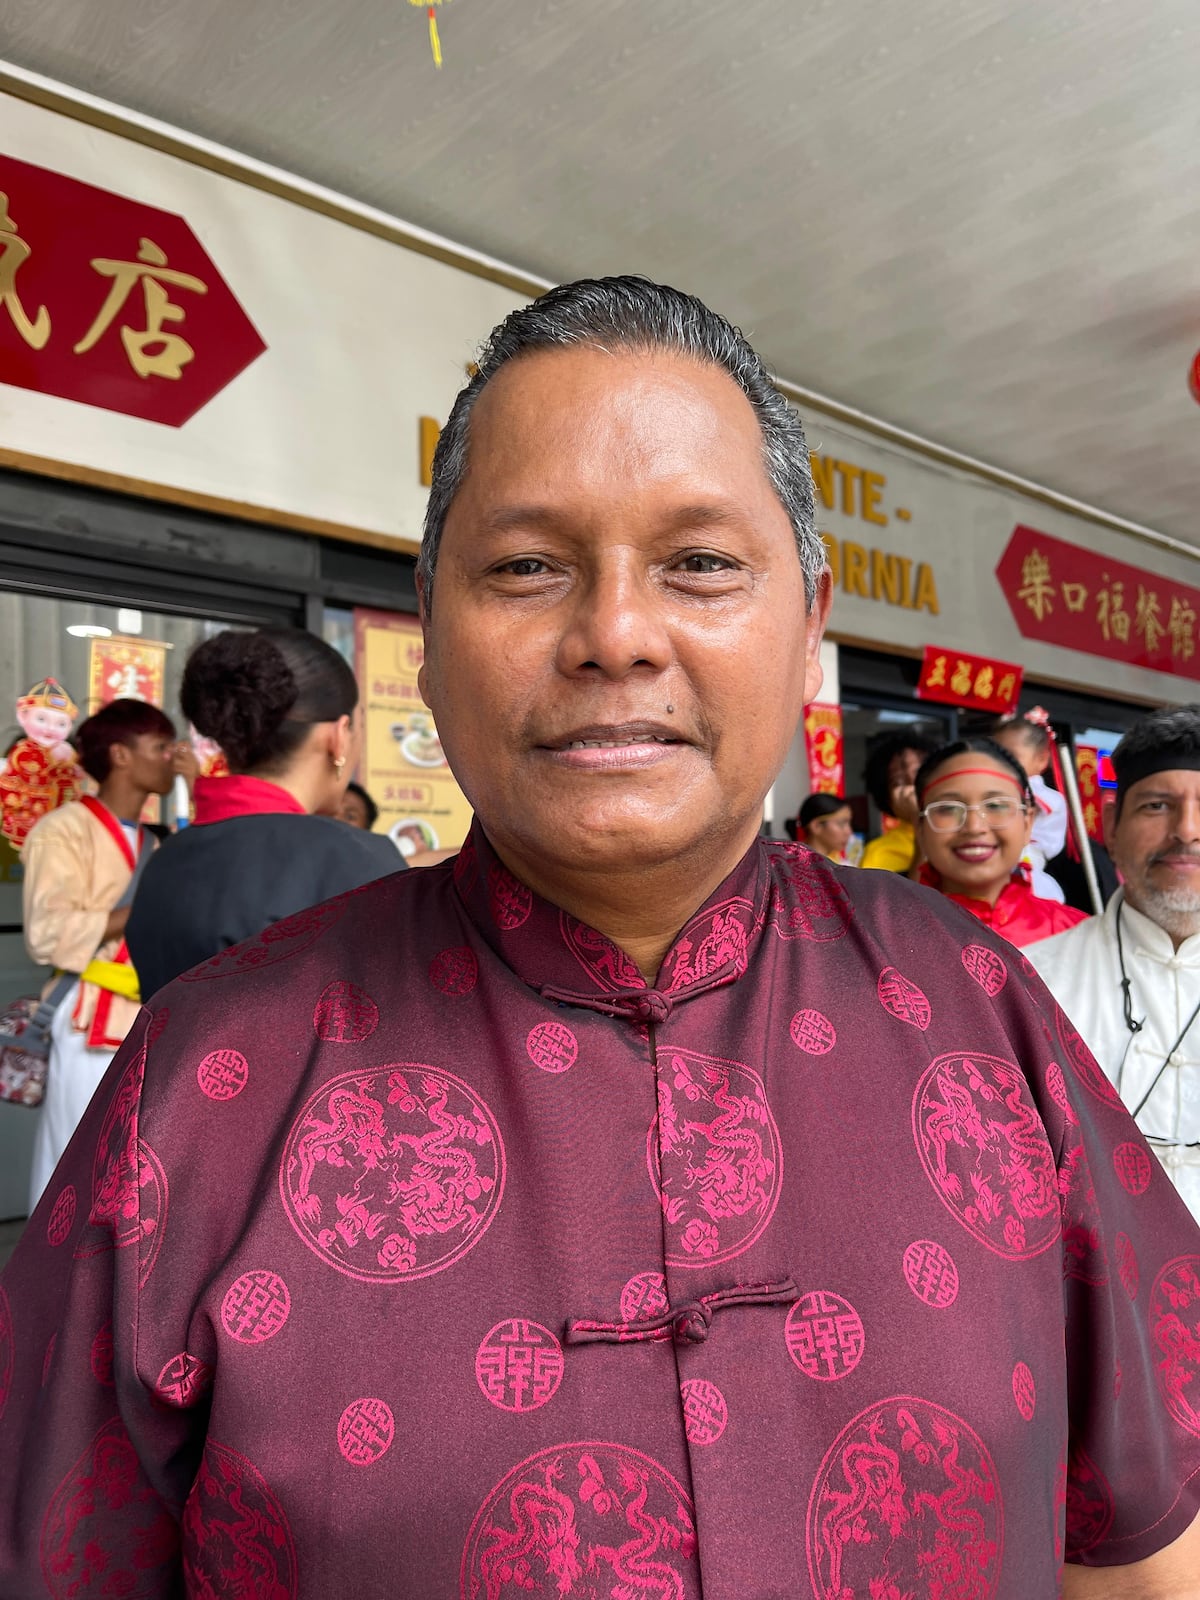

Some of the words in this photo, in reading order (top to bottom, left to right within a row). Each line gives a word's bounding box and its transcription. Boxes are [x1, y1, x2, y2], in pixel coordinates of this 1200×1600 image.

[810, 450, 888, 527] NTE
[820, 532, 940, 616] ORNIA
[1017, 548, 1200, 663] 樂口福餐館
